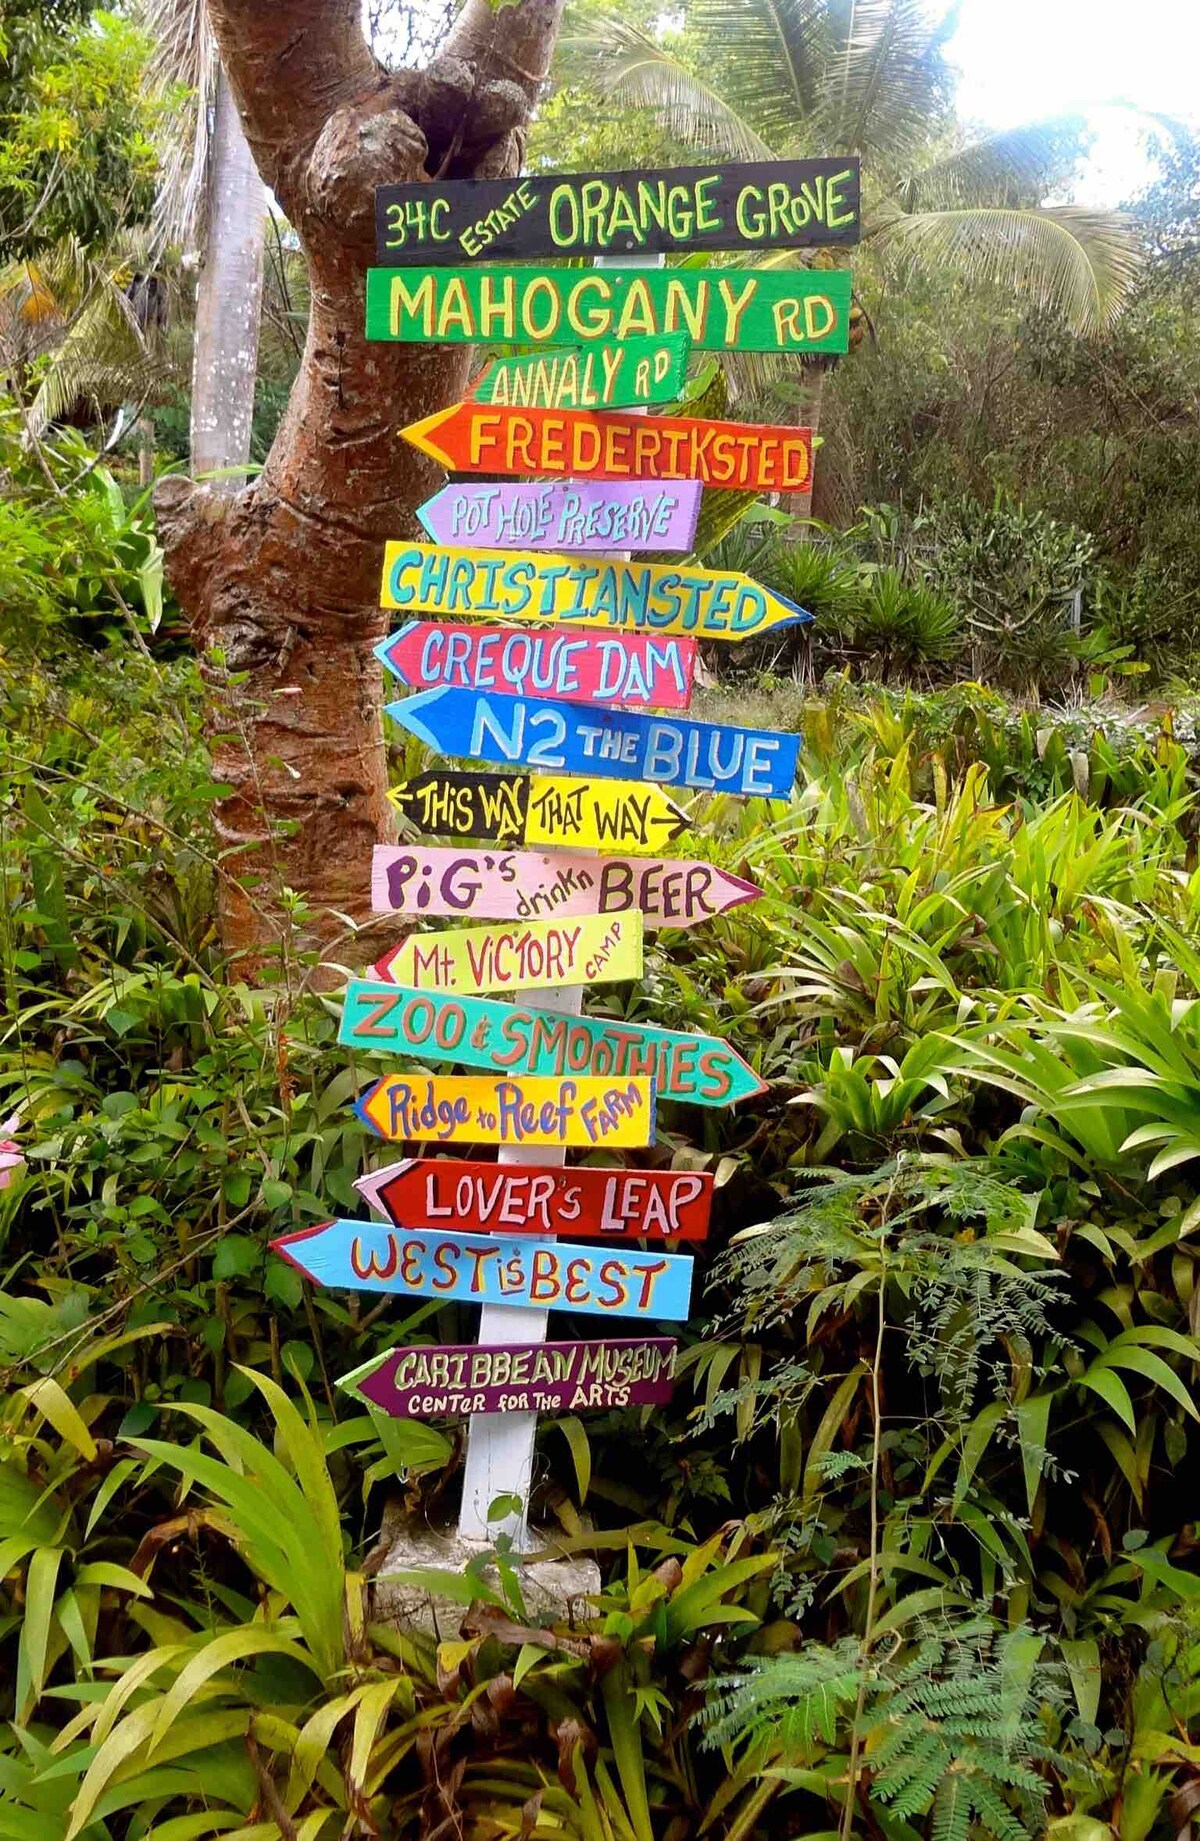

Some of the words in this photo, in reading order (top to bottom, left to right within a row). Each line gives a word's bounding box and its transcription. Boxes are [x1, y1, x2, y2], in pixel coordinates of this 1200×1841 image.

[385, 198, 451, 247] 34C
[458, 180, 539, 257] ESTATE
[549, 175, 721, 247] ORANGE
[736, 169, 855, 240] GROVE
[390, 275, 757, 344] MAHOGANY
[772, 295, 835, 346] RD
[491, 347, 624, 407] ANNALY
[636, 348, 670, 398] RD
[470, 414, 809, 487] FREDERIKSTED
[451, 488, 500, 536] POT
[496, 486, 555, 543] HOLE
[557, 490, 679, 544] PRESERVE
[389, 549, 770, 633] CHRISTIANSTED
[421, 629, 589, 693] CREQUE
[593, 639, 685, 701] DAM
[470, 698, 566, 767] N2
[576, 727, 640, 762] THE
[642, 724, 780, 794] BLUE
[479, 777, 525, 840] WAY
[532, 785, 589, 836] THAT
[594, 795, 652, 843] WAY
[598, 861, 717, 918] BEER
[585, 921, 622, 979] CAMP
[353, 993, 467, 1050] ZOO
[387, 1081, 471, 1140] Ridge
[476, 1105, 496, 1129] to
[496, 1081, 577, 1141] Reef
[580, 1082, 643, 1143] FARM
[600, 1173, 703, 1235] LEAP
[350, 1234, 500, 1293] WEST
[497, 1252, 525, 1296] is
[530, 1250, 667, 1310] BEST
[394, 1346, 578, 1391] CARIBBEAN
[577, 1341, 678, 1385] MUSEUM
[569, 1384, 630, 1408] ARTS
